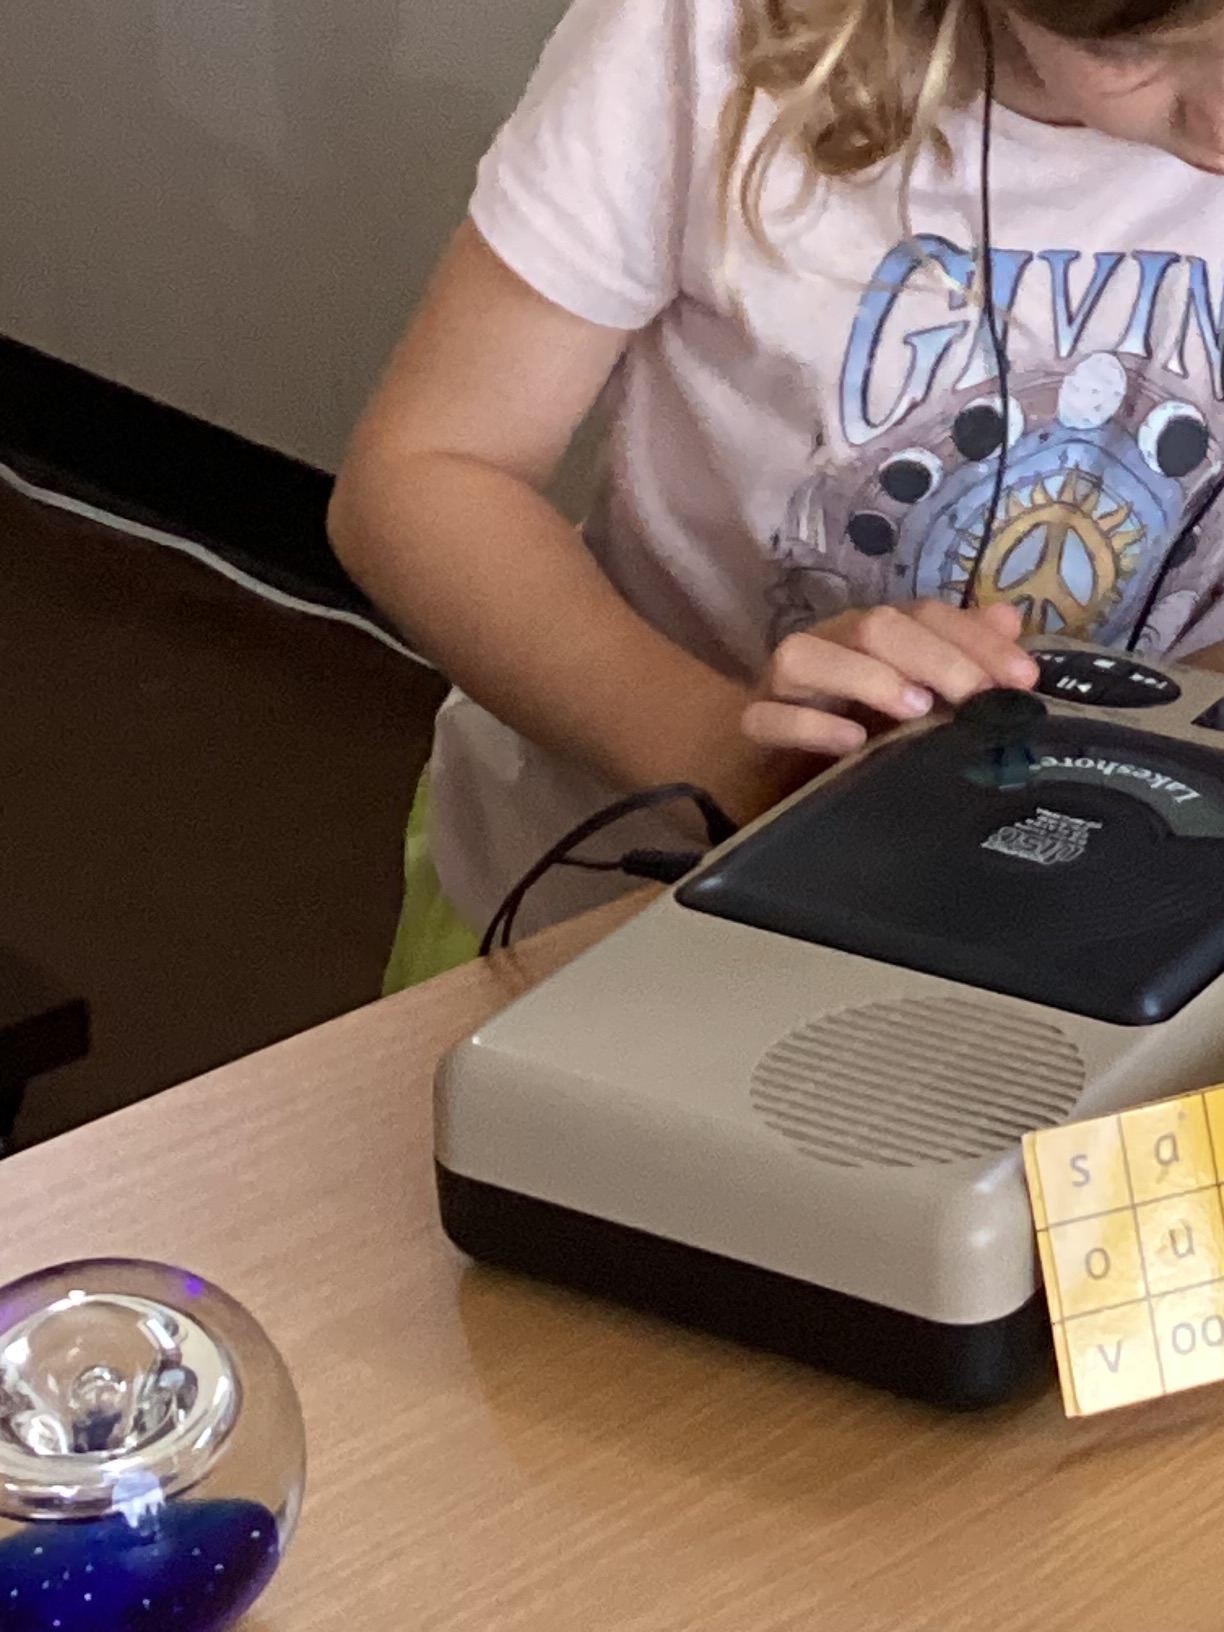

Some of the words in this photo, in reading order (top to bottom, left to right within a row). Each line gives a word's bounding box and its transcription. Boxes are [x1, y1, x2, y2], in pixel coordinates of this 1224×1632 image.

[1070, 1154, 1090, 1188] s
[1154, 1133, 1179, 1168] a
[1085, 1248, 1111, 1280] o
[1169, 1220, 1196, 1259] u
[1097, 1339, 1123, 1373] v
[1172, 1314, 1224, 1355] oo
